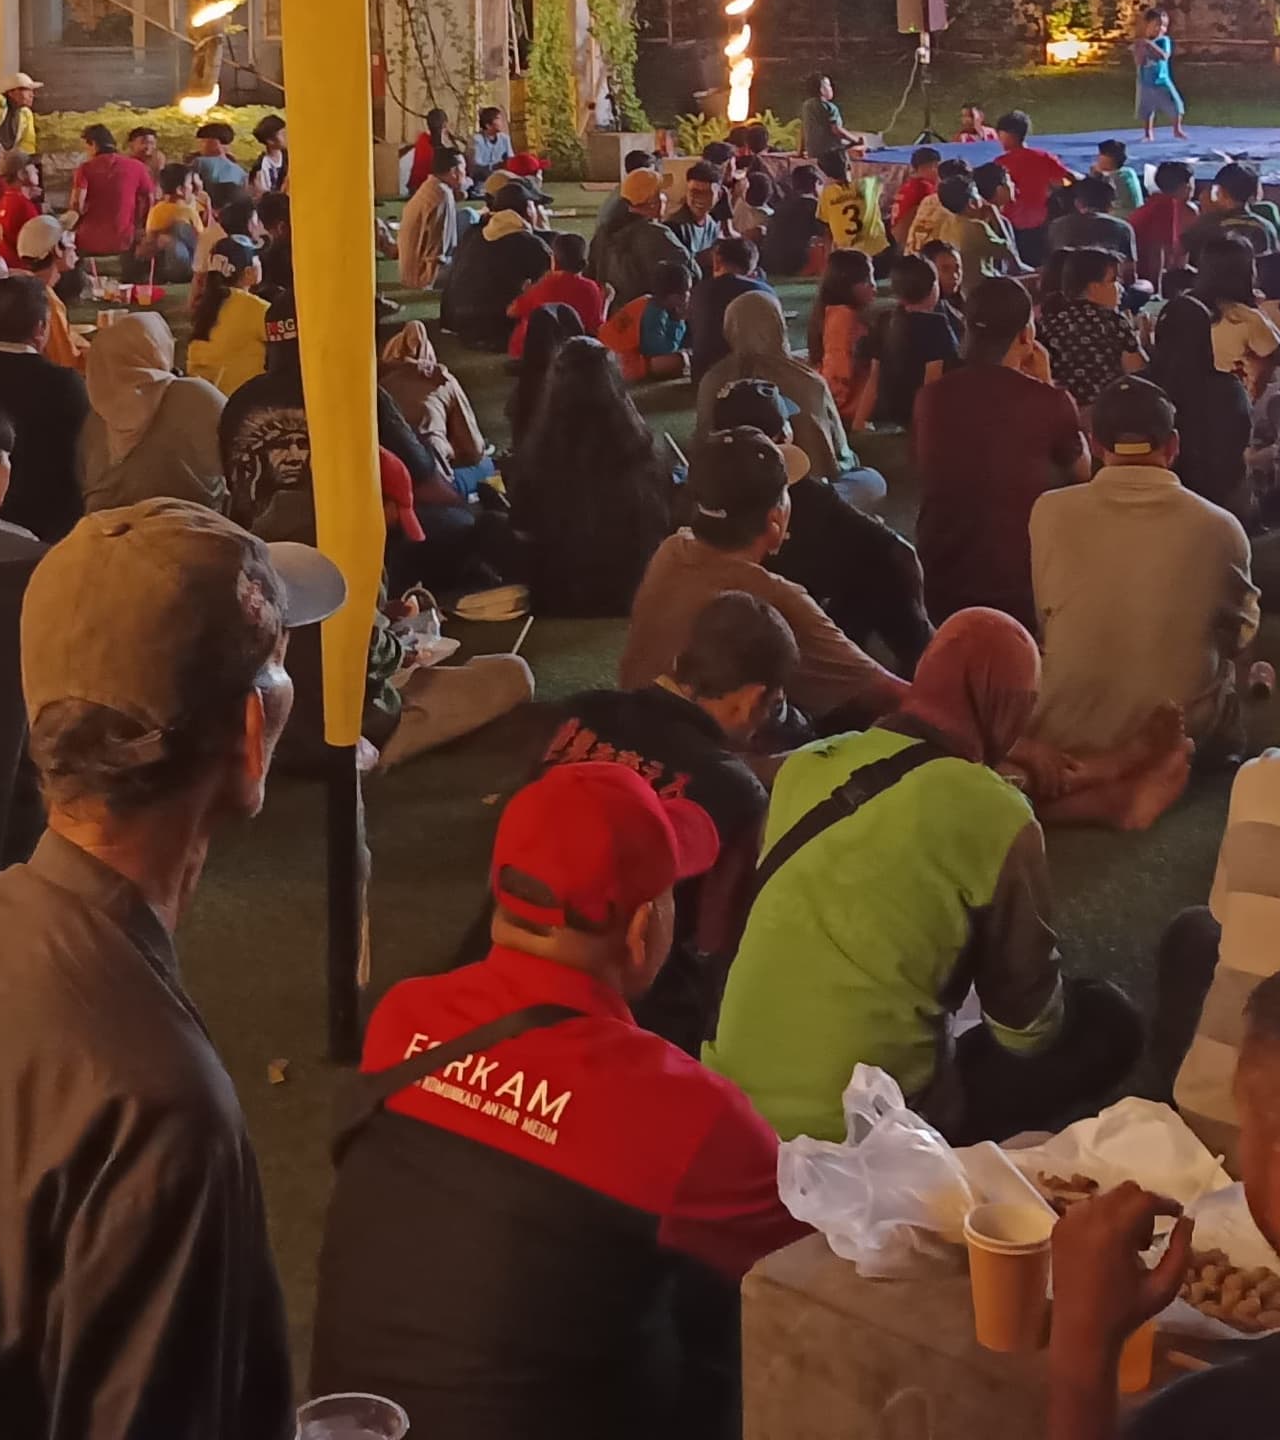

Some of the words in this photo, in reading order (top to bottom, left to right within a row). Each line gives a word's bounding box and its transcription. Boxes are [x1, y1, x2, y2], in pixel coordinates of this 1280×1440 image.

[842, 204, 863, 235] 3
[403, 1032, 572, 1125] FRKAM
[480, 1100, 520, 1126] ANTAR
[521, 1117, 559, 1146] MEDIA
